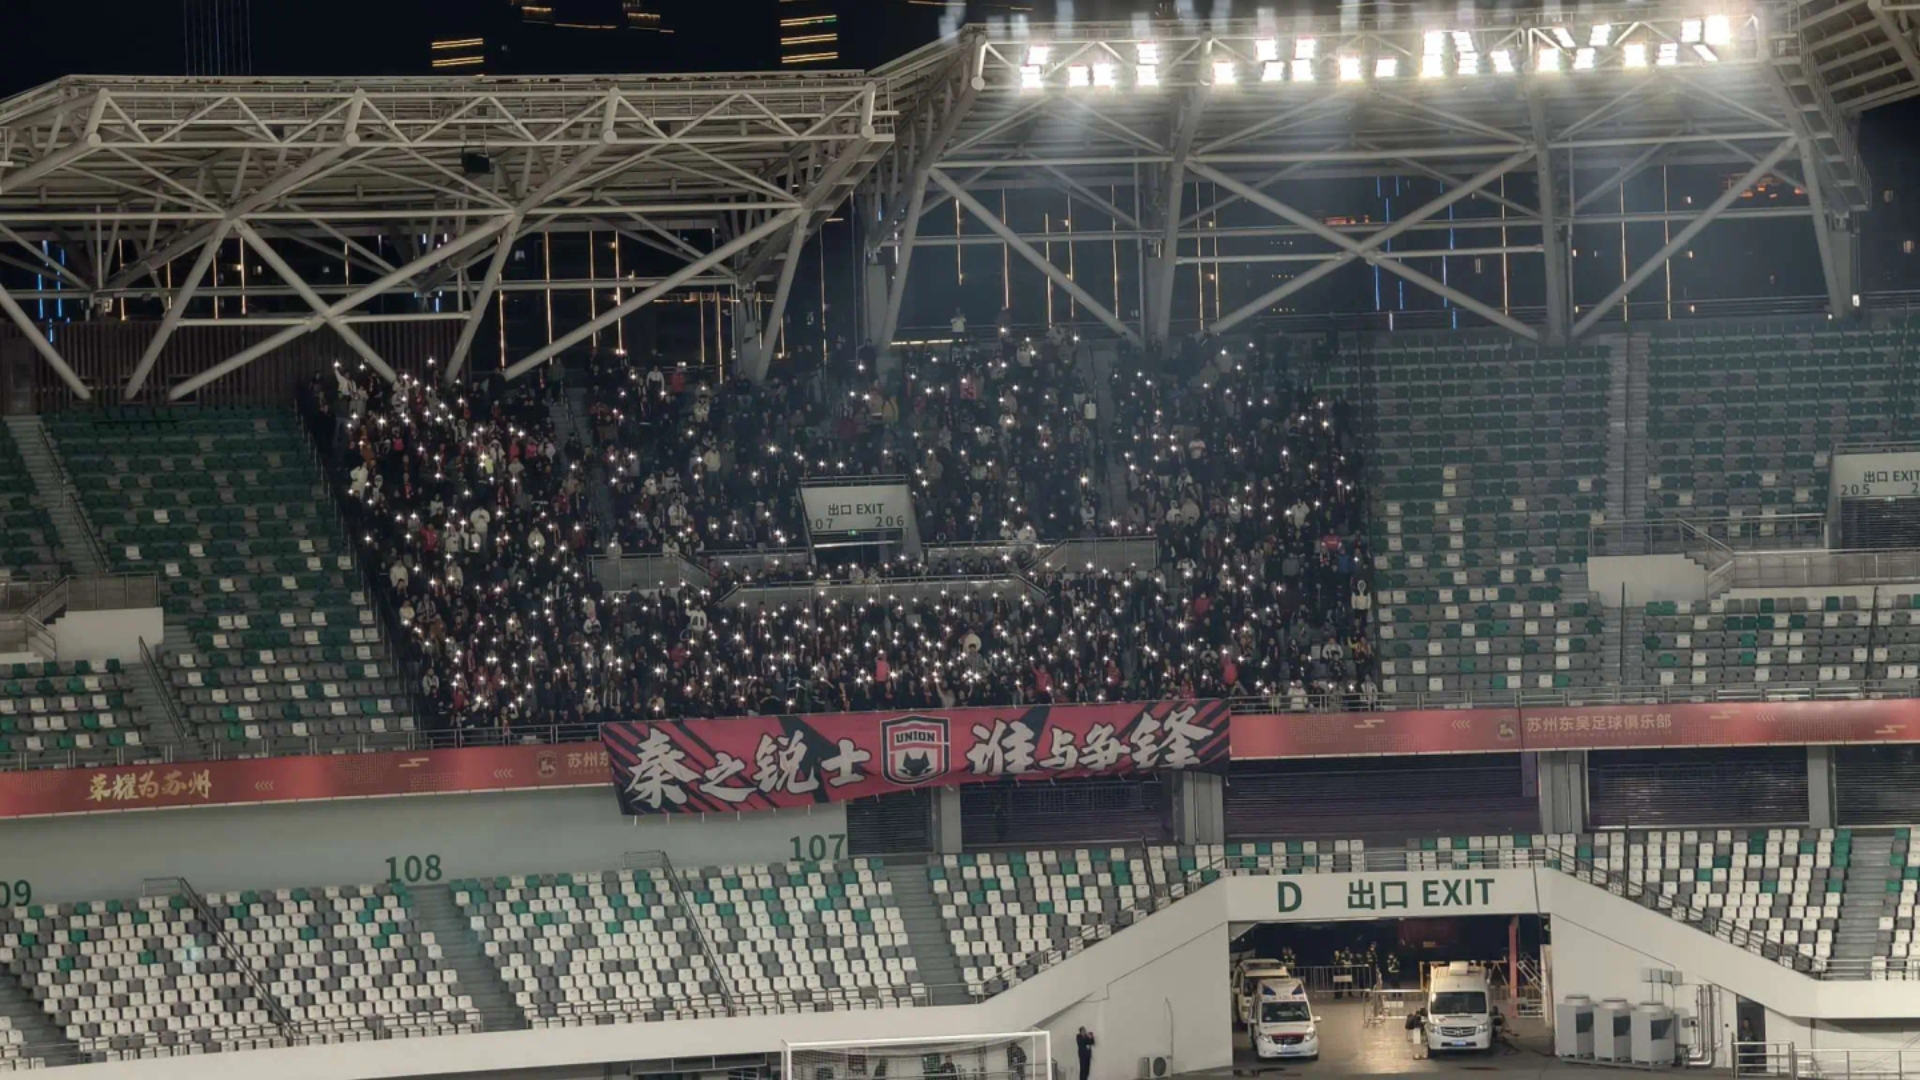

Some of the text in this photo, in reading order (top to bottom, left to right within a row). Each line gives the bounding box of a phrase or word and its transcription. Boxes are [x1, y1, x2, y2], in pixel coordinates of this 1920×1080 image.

[1863, 470, 1920, 483] 出口 EXIT
[1841, 484, 1870, 495] 205
[828, 503, 884, 516] 出口 EXIT
[808, 518, 833, 529] 07
[875, 515, 905, 527] 206
[1526, 713, 1672, 732] 苏州东吴足球俱乐部
[895, 730, 936, 743] UNION
[624, 705, 1214, 809] 秦之锐士 谁与争锋
[85, 769, 212, 802] 荣耀为苏州
[789, 834, 846, 861] 107
[385, 854, 442, 884] 108
[1277, 878, 1495, 913] D 出口 EXIT
